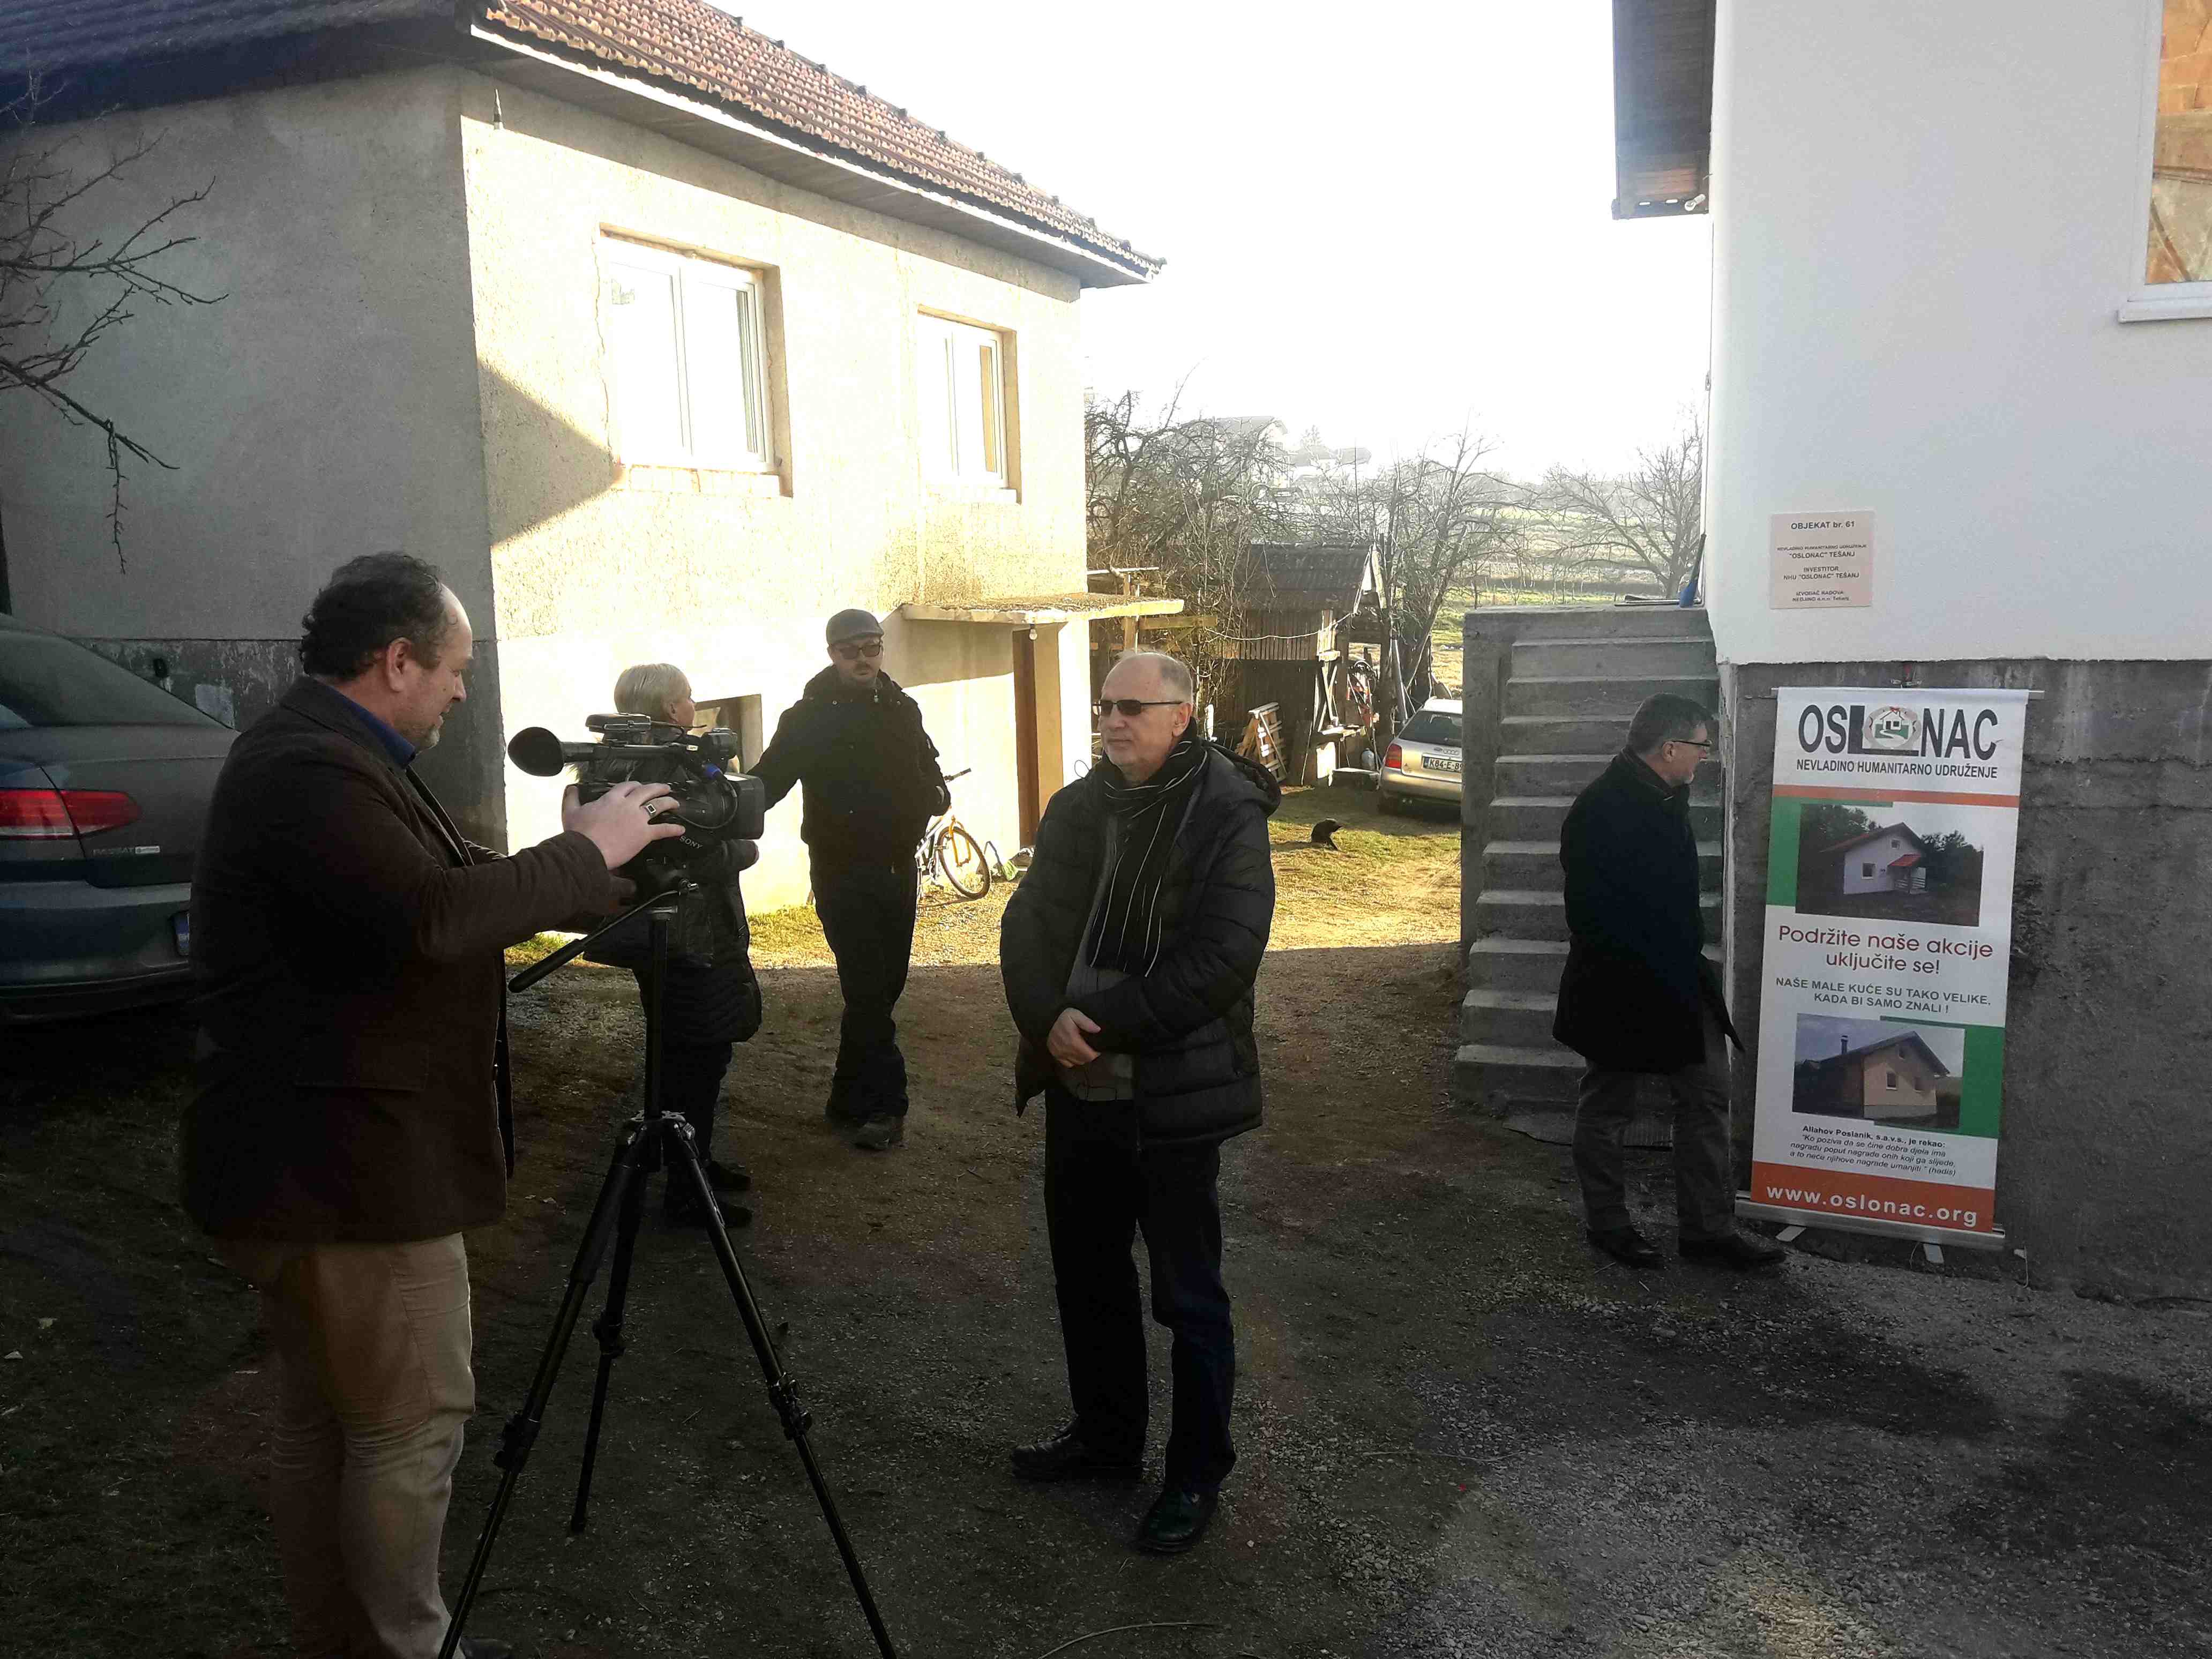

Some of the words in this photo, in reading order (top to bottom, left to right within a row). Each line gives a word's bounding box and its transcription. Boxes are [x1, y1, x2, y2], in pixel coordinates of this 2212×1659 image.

[1796, 758, 1855, 773] NEVLADINO
[1856, 761, 1932, 776] HUMANITARNO
[1935, 763, 1998, 779] UDRUŽENJE
[679, 835, 704, 849] SONY
[1778, 925, 1861, 947] Podržite
[1867, 933, 1920, 952] naše
[1926, 939, 1993, 961] akcije
[1826, 952, 1907, 972] uključite
[1912, 959, 1940, 974] se!
[1775, 976, 1808, 989] NAŠE
[1812, 980, 1845, 992] MALE
[1848, 982, 1882, 995] KUĆE
[1886, 986, 1903, 997] SU
[1906, 988, 1939, 1000] TAKO
[1814, 992, 1849, 1004] KADA
[1851, 995, 1864, 1005] BI
[1867, 997, 1903, 1009] SAMO
[1905, 1000, 1942, 1013] ZNALI
[1803, 1125, 1834, 1135] Allahov
[1836, 1129, 1873, 1140] Poslanik,
[1908, 1137, 1917, 1146] je
[1919, 1139, 1946, 1148] rekao:
[1816, 1137, 1842, 1145] poziva
[1886, 1144, 1909, 1153] dobra
[1910, 1147, 1930, 1155] djela
[1931, 1149, 1946, 1157] ima
[1790, 1142, 1822, 1152] nagradu
[1824, 1146, 1847, 1155] poput
[1881, 1152, 1899, 1160] onih
[1901, 1154, 1914, 1163] koji
[1916, 1157, 1926, 1165] ga
[1826, 1155, 1855, 1164] njihove
[1856, 1157, 1889, 1168] nagrade
[1929, 1167, 1956, 1177] (hadis)
[1766, 1185, 1978, 1228] www.oslonac.org
